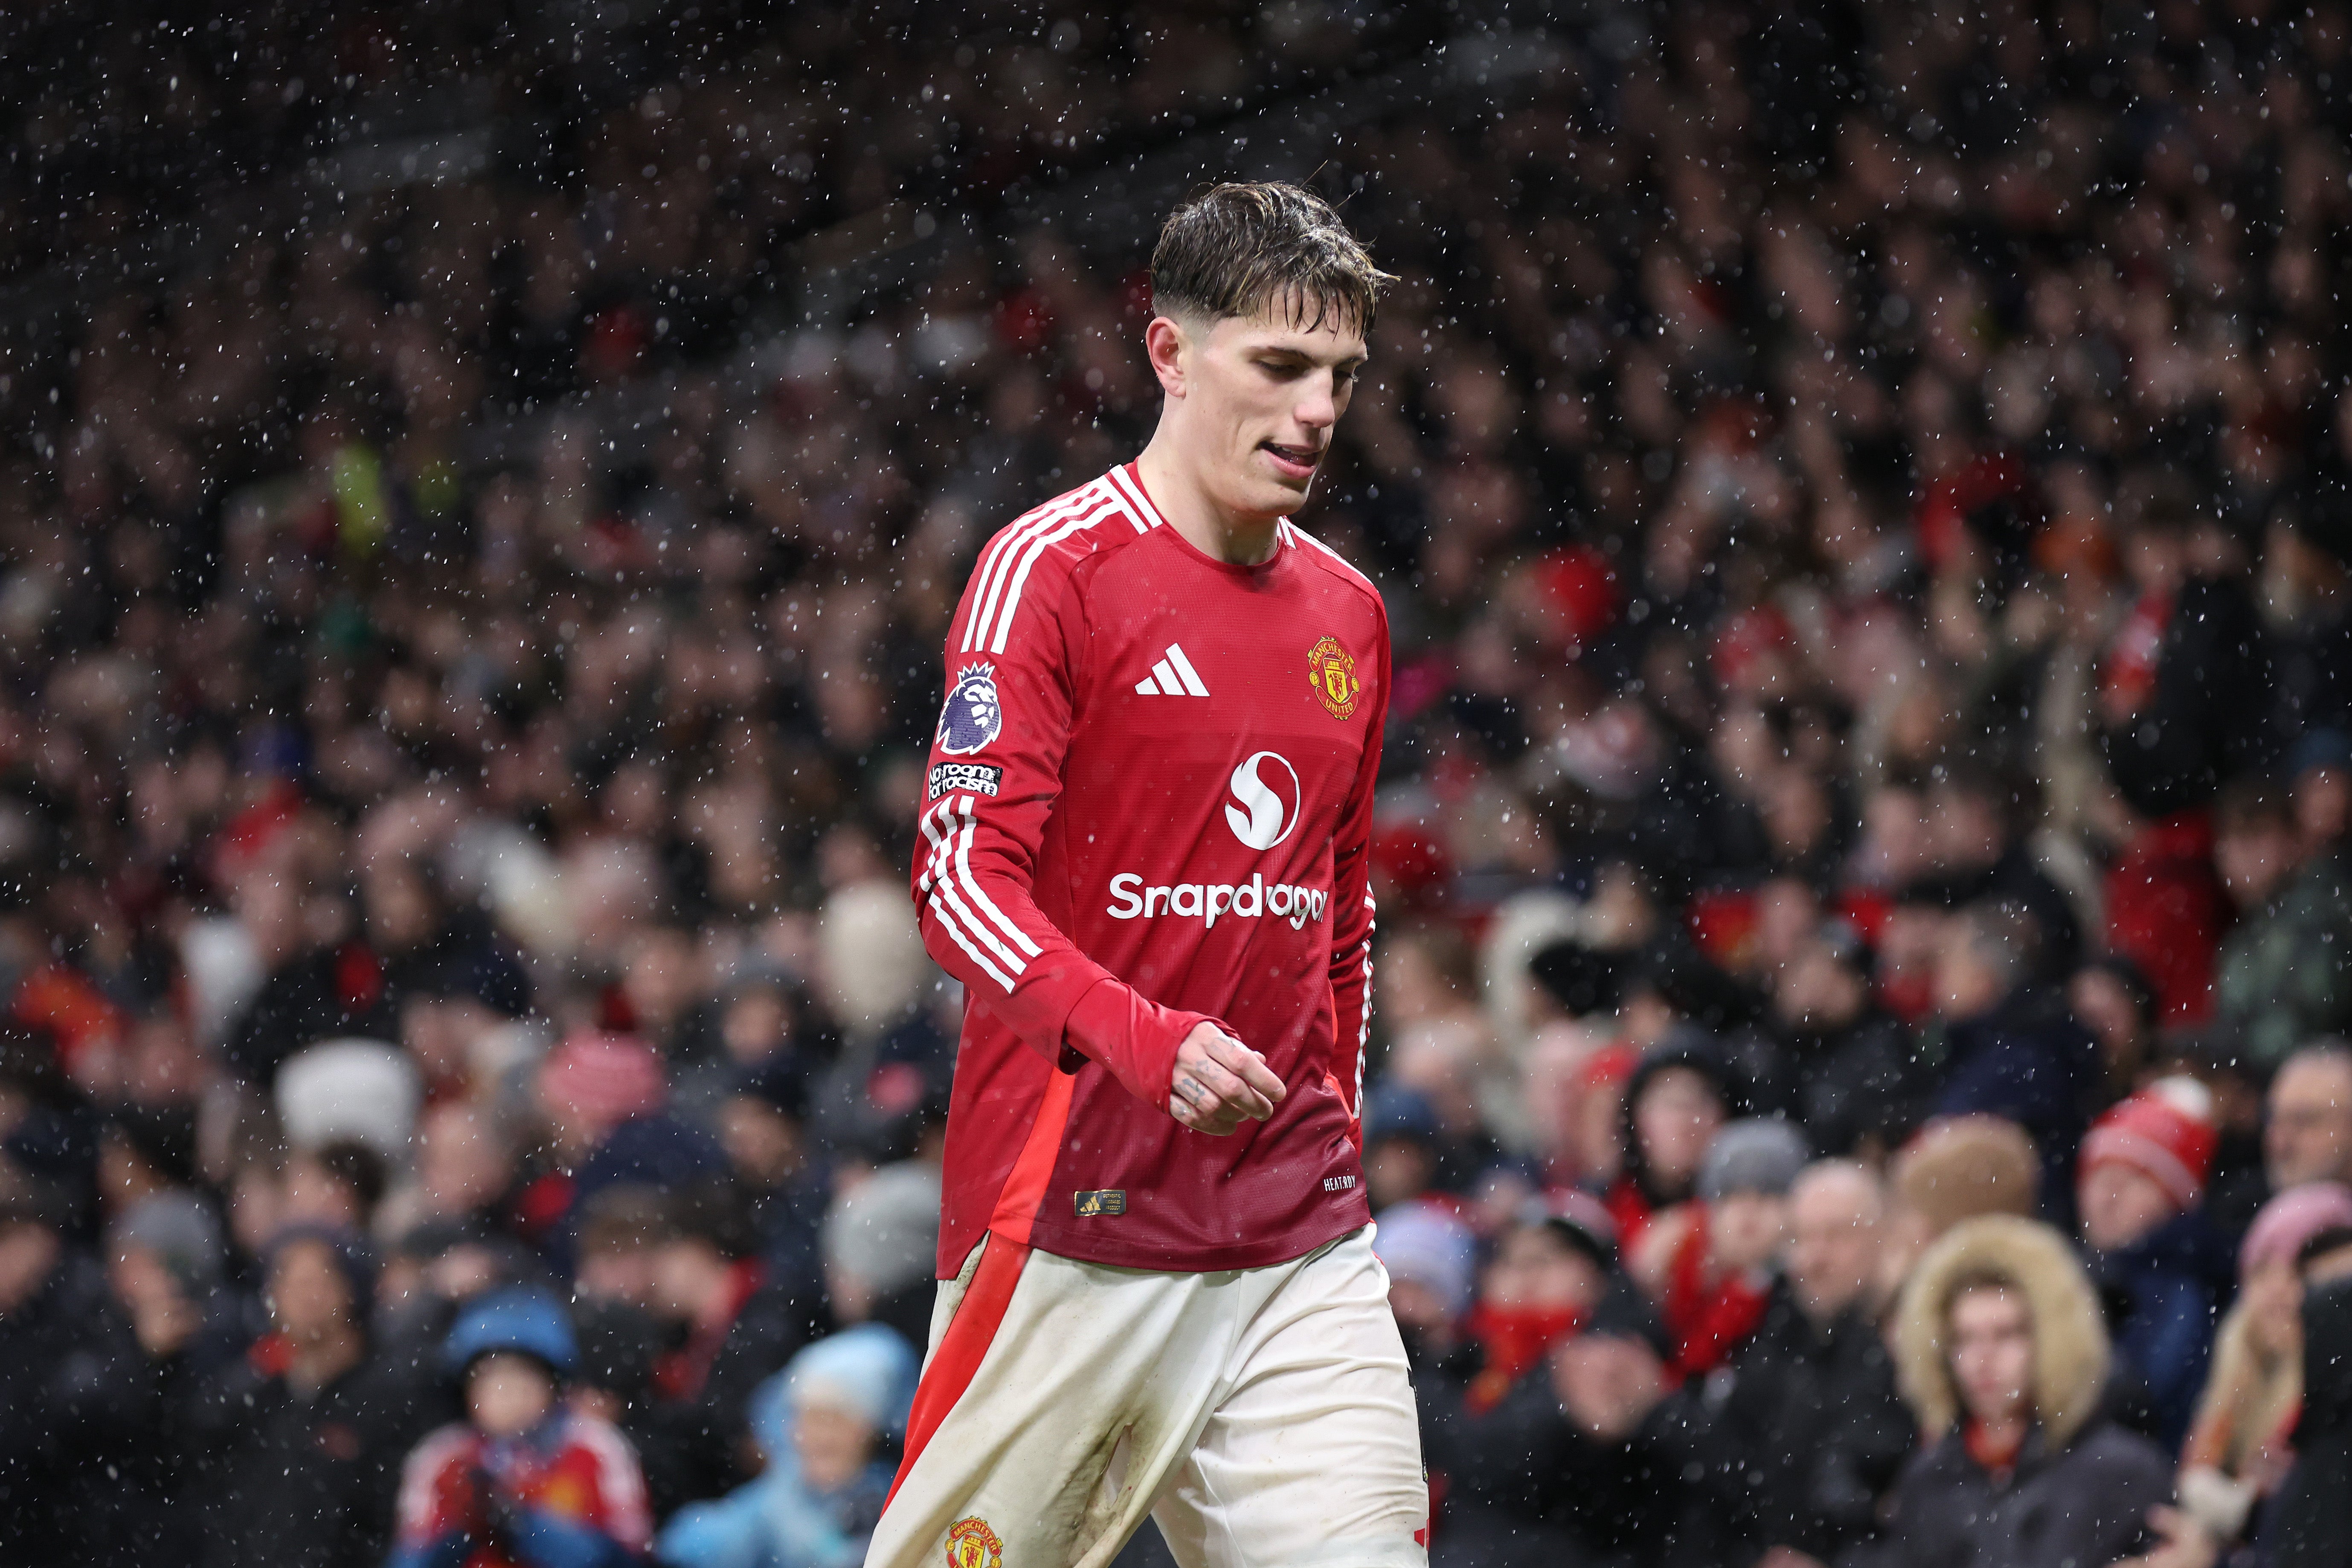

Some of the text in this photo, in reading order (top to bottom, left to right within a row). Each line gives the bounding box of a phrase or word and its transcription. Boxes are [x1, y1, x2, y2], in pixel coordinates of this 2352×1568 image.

[1312, 643, 1352, 671] MANCHESTER
[1325, 699, 1353, 714] UNITED
[929, 764, 995, 784] No room
[929, 776, 998, 802] for racism
[1324, 1175, 1356, 1192] HEAT.RDY
[954, 1522, 997, 1552] MANCHESTER
